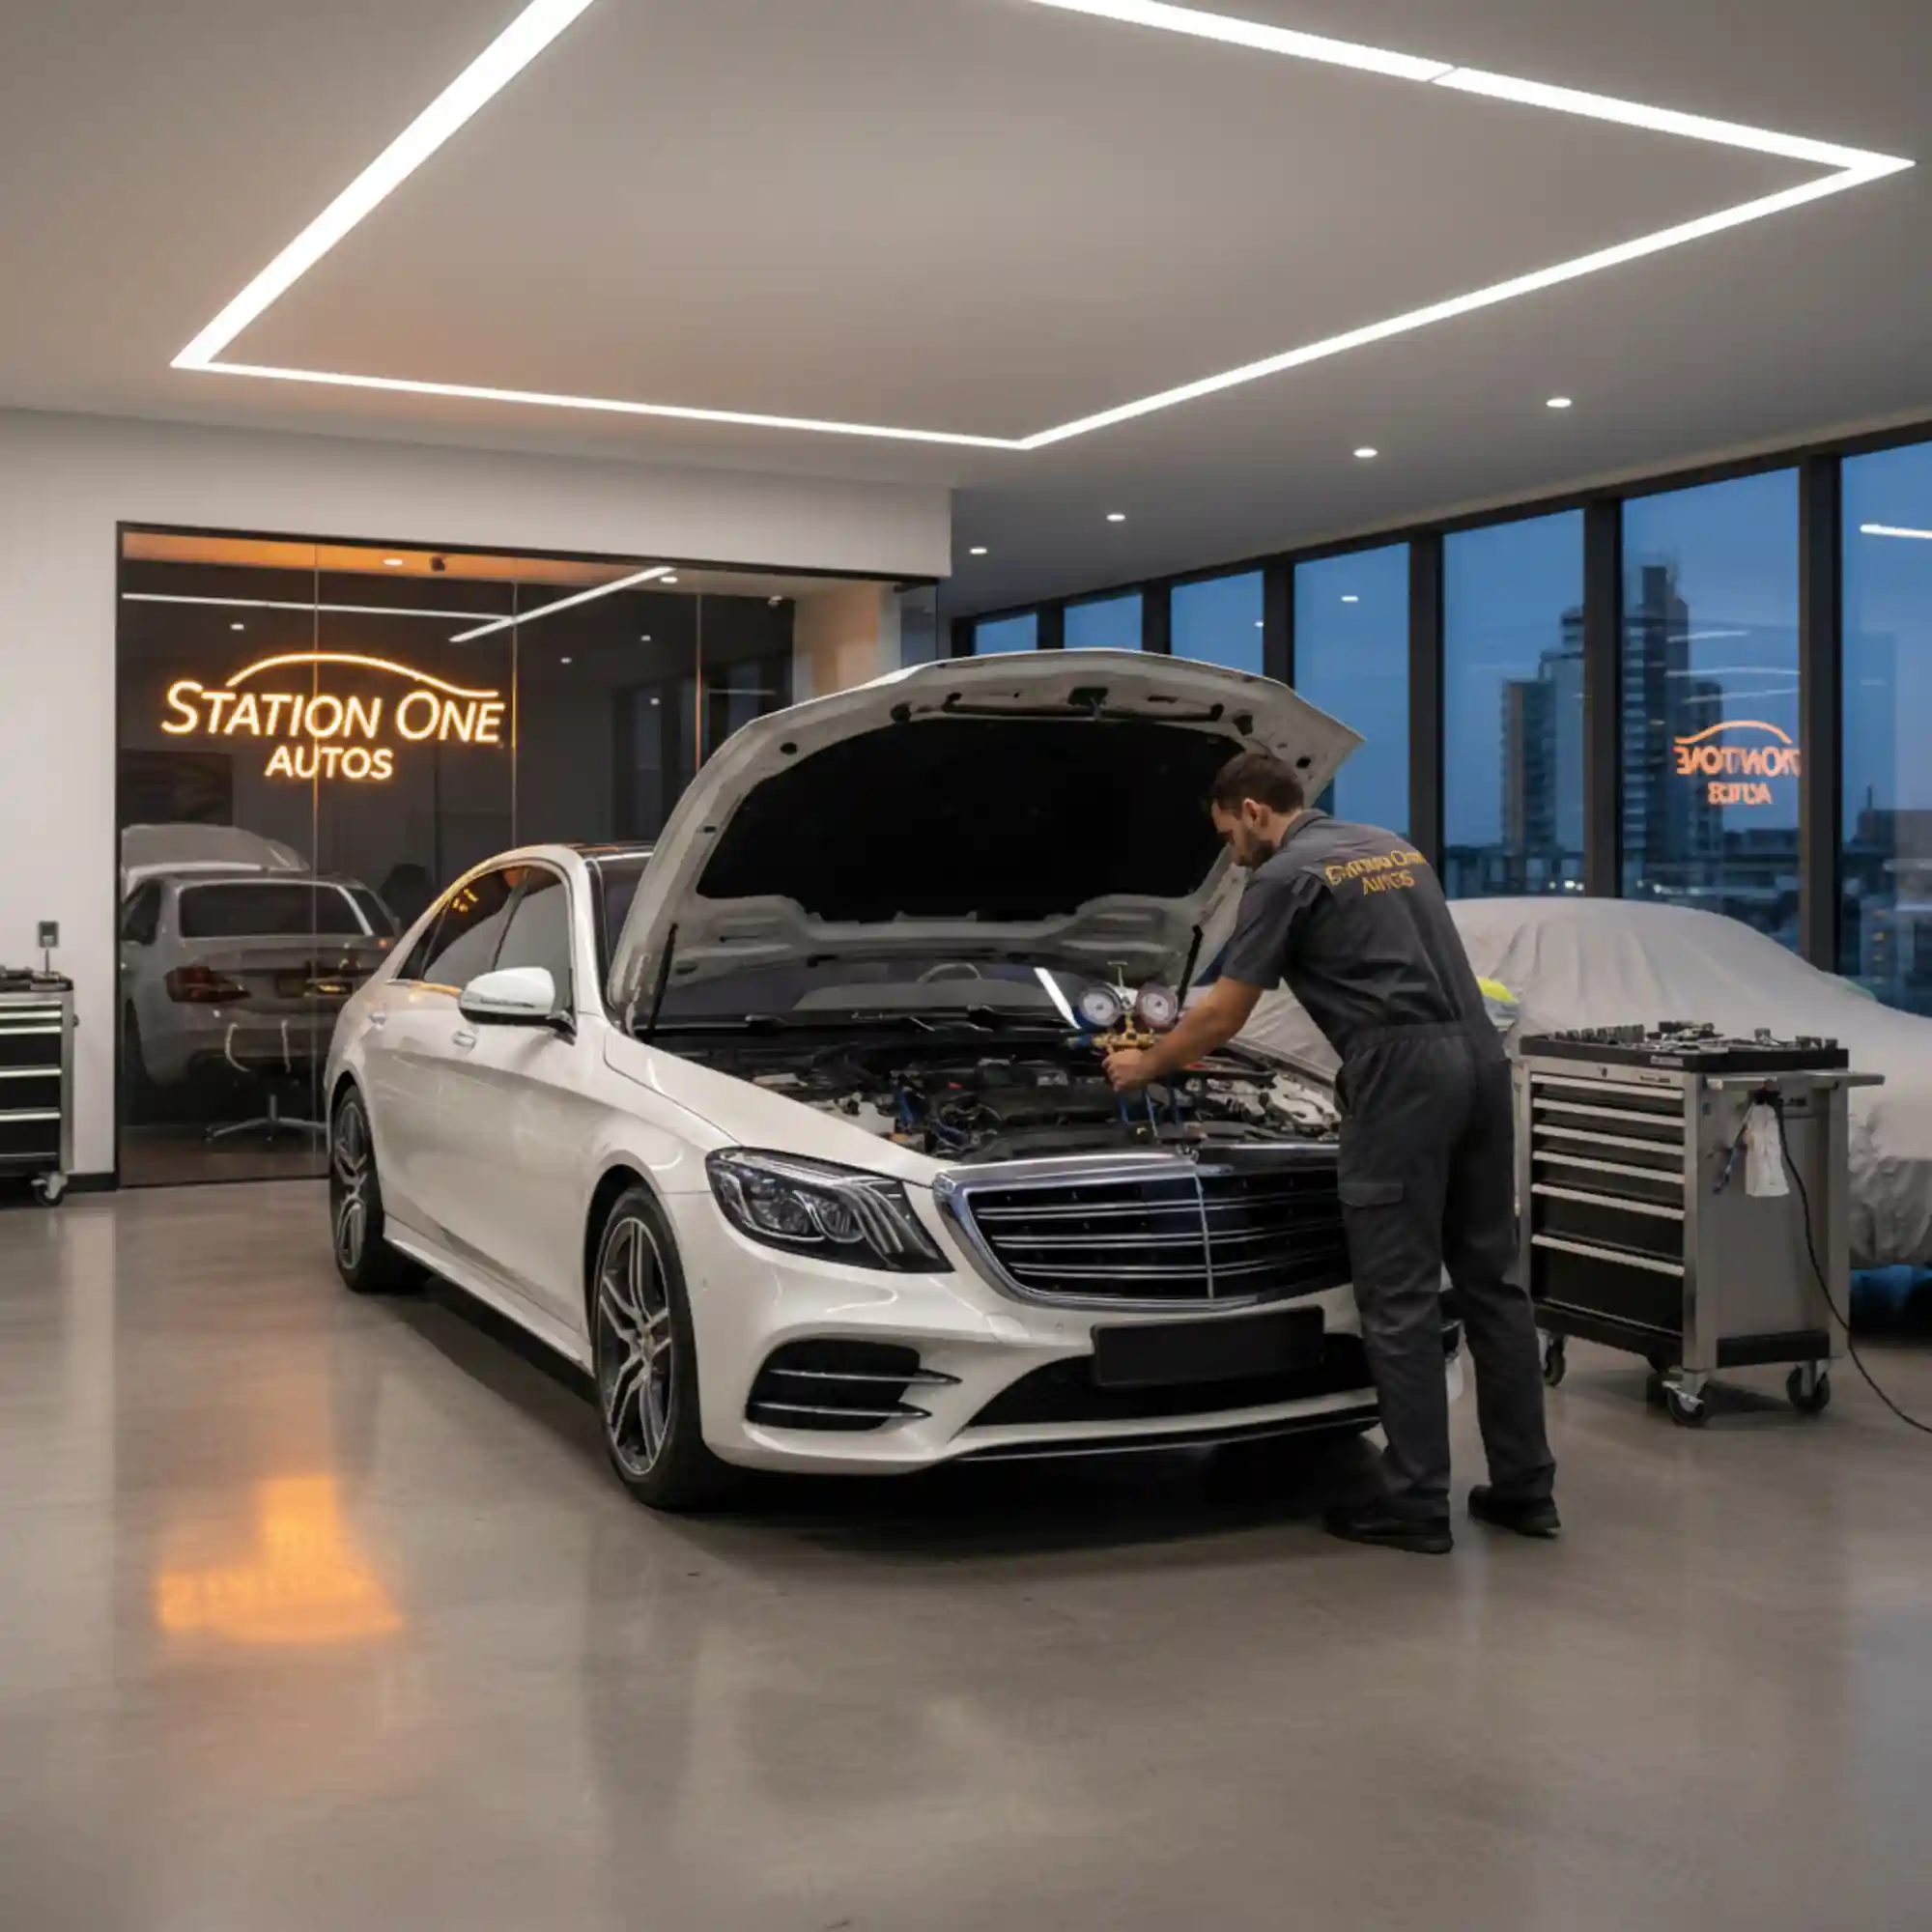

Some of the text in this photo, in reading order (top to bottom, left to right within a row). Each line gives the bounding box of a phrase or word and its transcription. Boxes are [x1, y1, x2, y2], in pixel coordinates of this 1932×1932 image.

[160, 680, 505, 743] STATION ONE
[264, 745, 394, 781] AUTOS
